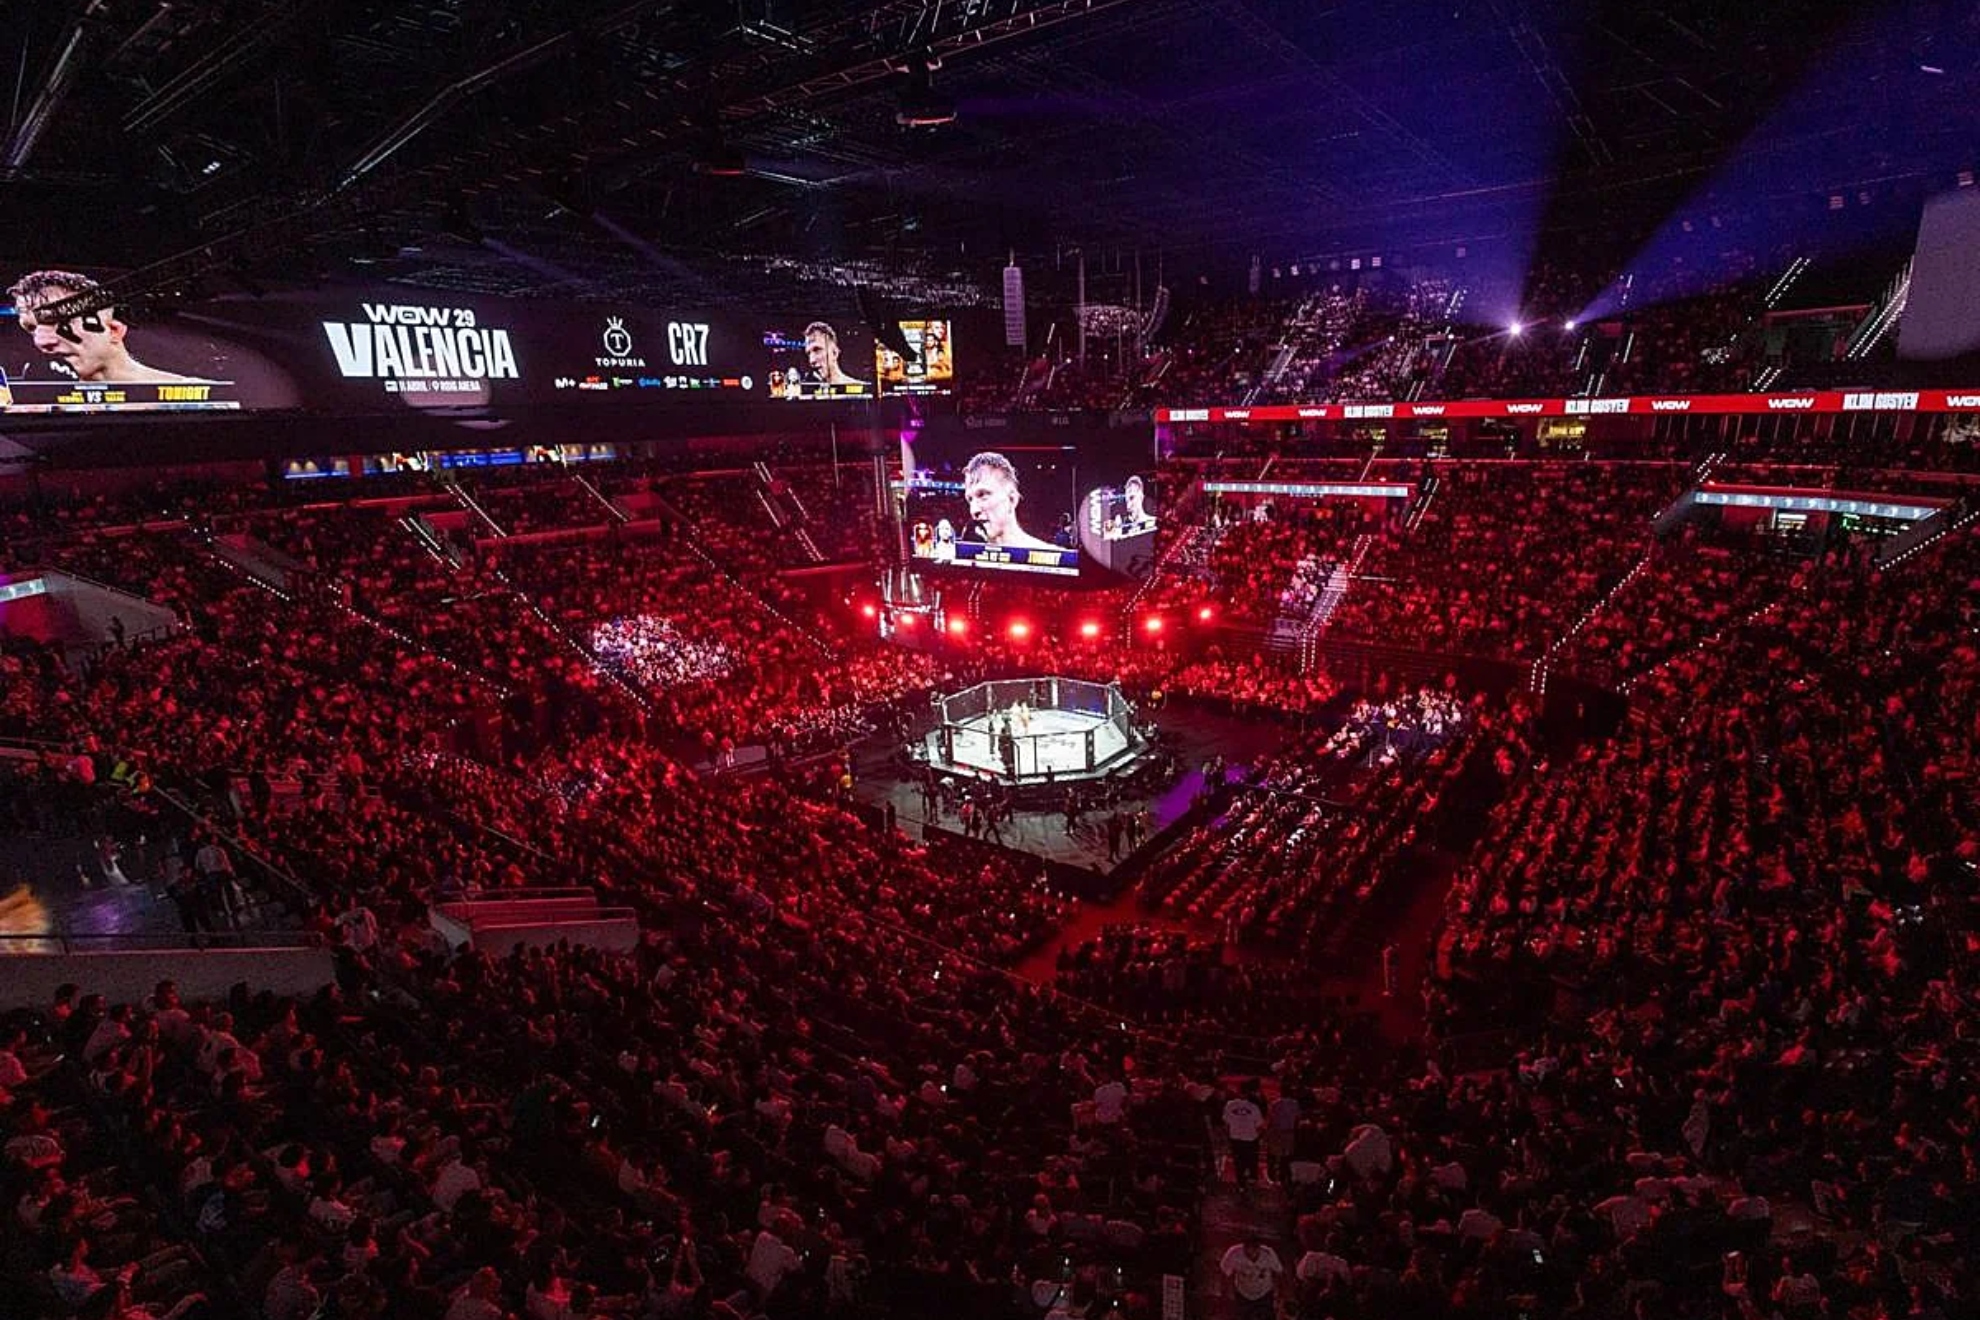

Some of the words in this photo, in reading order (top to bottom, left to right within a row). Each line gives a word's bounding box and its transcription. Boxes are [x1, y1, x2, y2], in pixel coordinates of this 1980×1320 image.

[362, 303, 450, 326] WOW
[453, 308, 476, 328] 29
[667, 321, 710, 366] CR7
[323, 321, 520, 379] VALENCIA
[595, 357, 646, 367] TOPURIA
[87, 391, 102, 403] VS
[157, 385, 211, 401] TONIGHT
[1651, 400, 1690, 410] WOW
[1768, 398, 1814, 408] WOW
[1412, 406, 1445, 415] WOW
[1507, 404, 1544, 414] WOW
